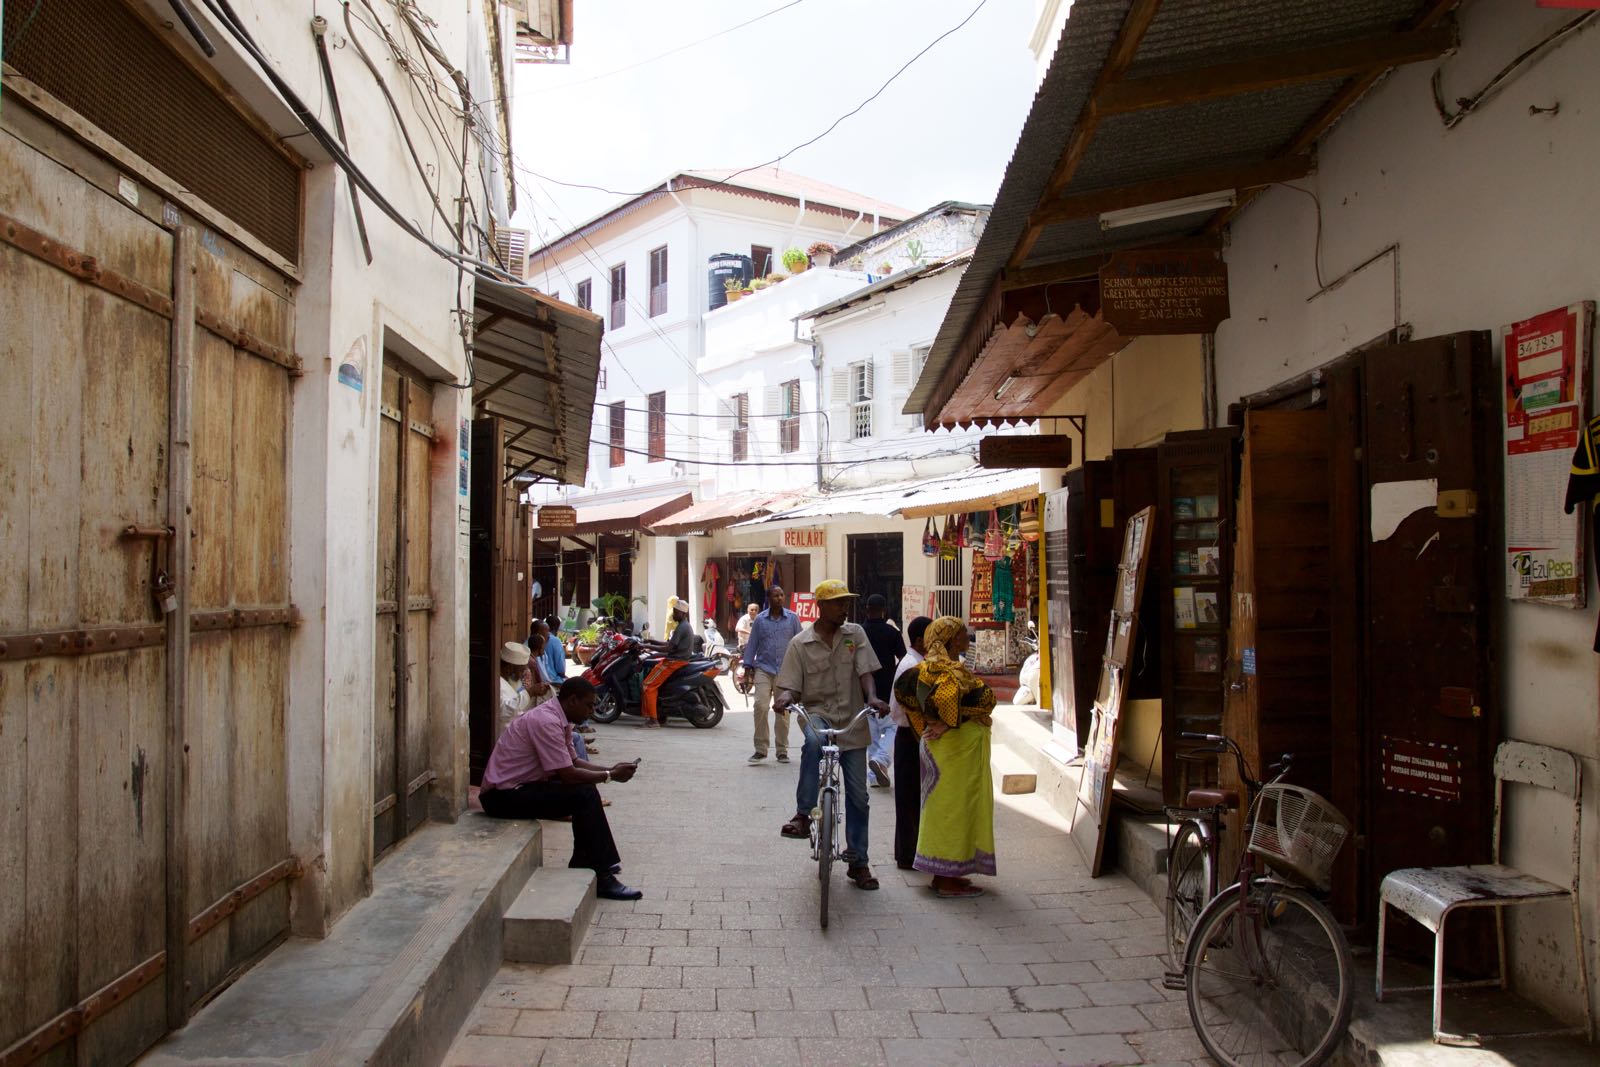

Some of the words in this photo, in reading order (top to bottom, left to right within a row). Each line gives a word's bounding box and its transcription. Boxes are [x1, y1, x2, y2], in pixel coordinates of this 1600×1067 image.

[1104, 278, 1135, 288] SCHOOL
[1137, 278, 1152, 288] AND
[1153, 277, 1178, 287] OFFICE
[1103, 288, 1140, 299] GREETING
[1141, 288, 1166, 298] CARDS
[1174, 286, 1226, 297] DECORATIONS
[1113, 299, 1156, 310] GIZENGA
[1159, 298, 1201, 309] STREET
[1139, 308, 1204, 320] ZANZIBAR
[1519, 334, 1556, 356] 34783
[784, 531, 805, 546] REAL
[807, 531, 824, 546] ART
[1532, 559, 1573, 581] EzyPesa
[1390, 765, 1410, 775] POSTAGE
[1410, 768, 1427, 779] STAMPS
[1428, 771, 1440, 781] SOLD
[1440, 774, 1453, 784] HERE
